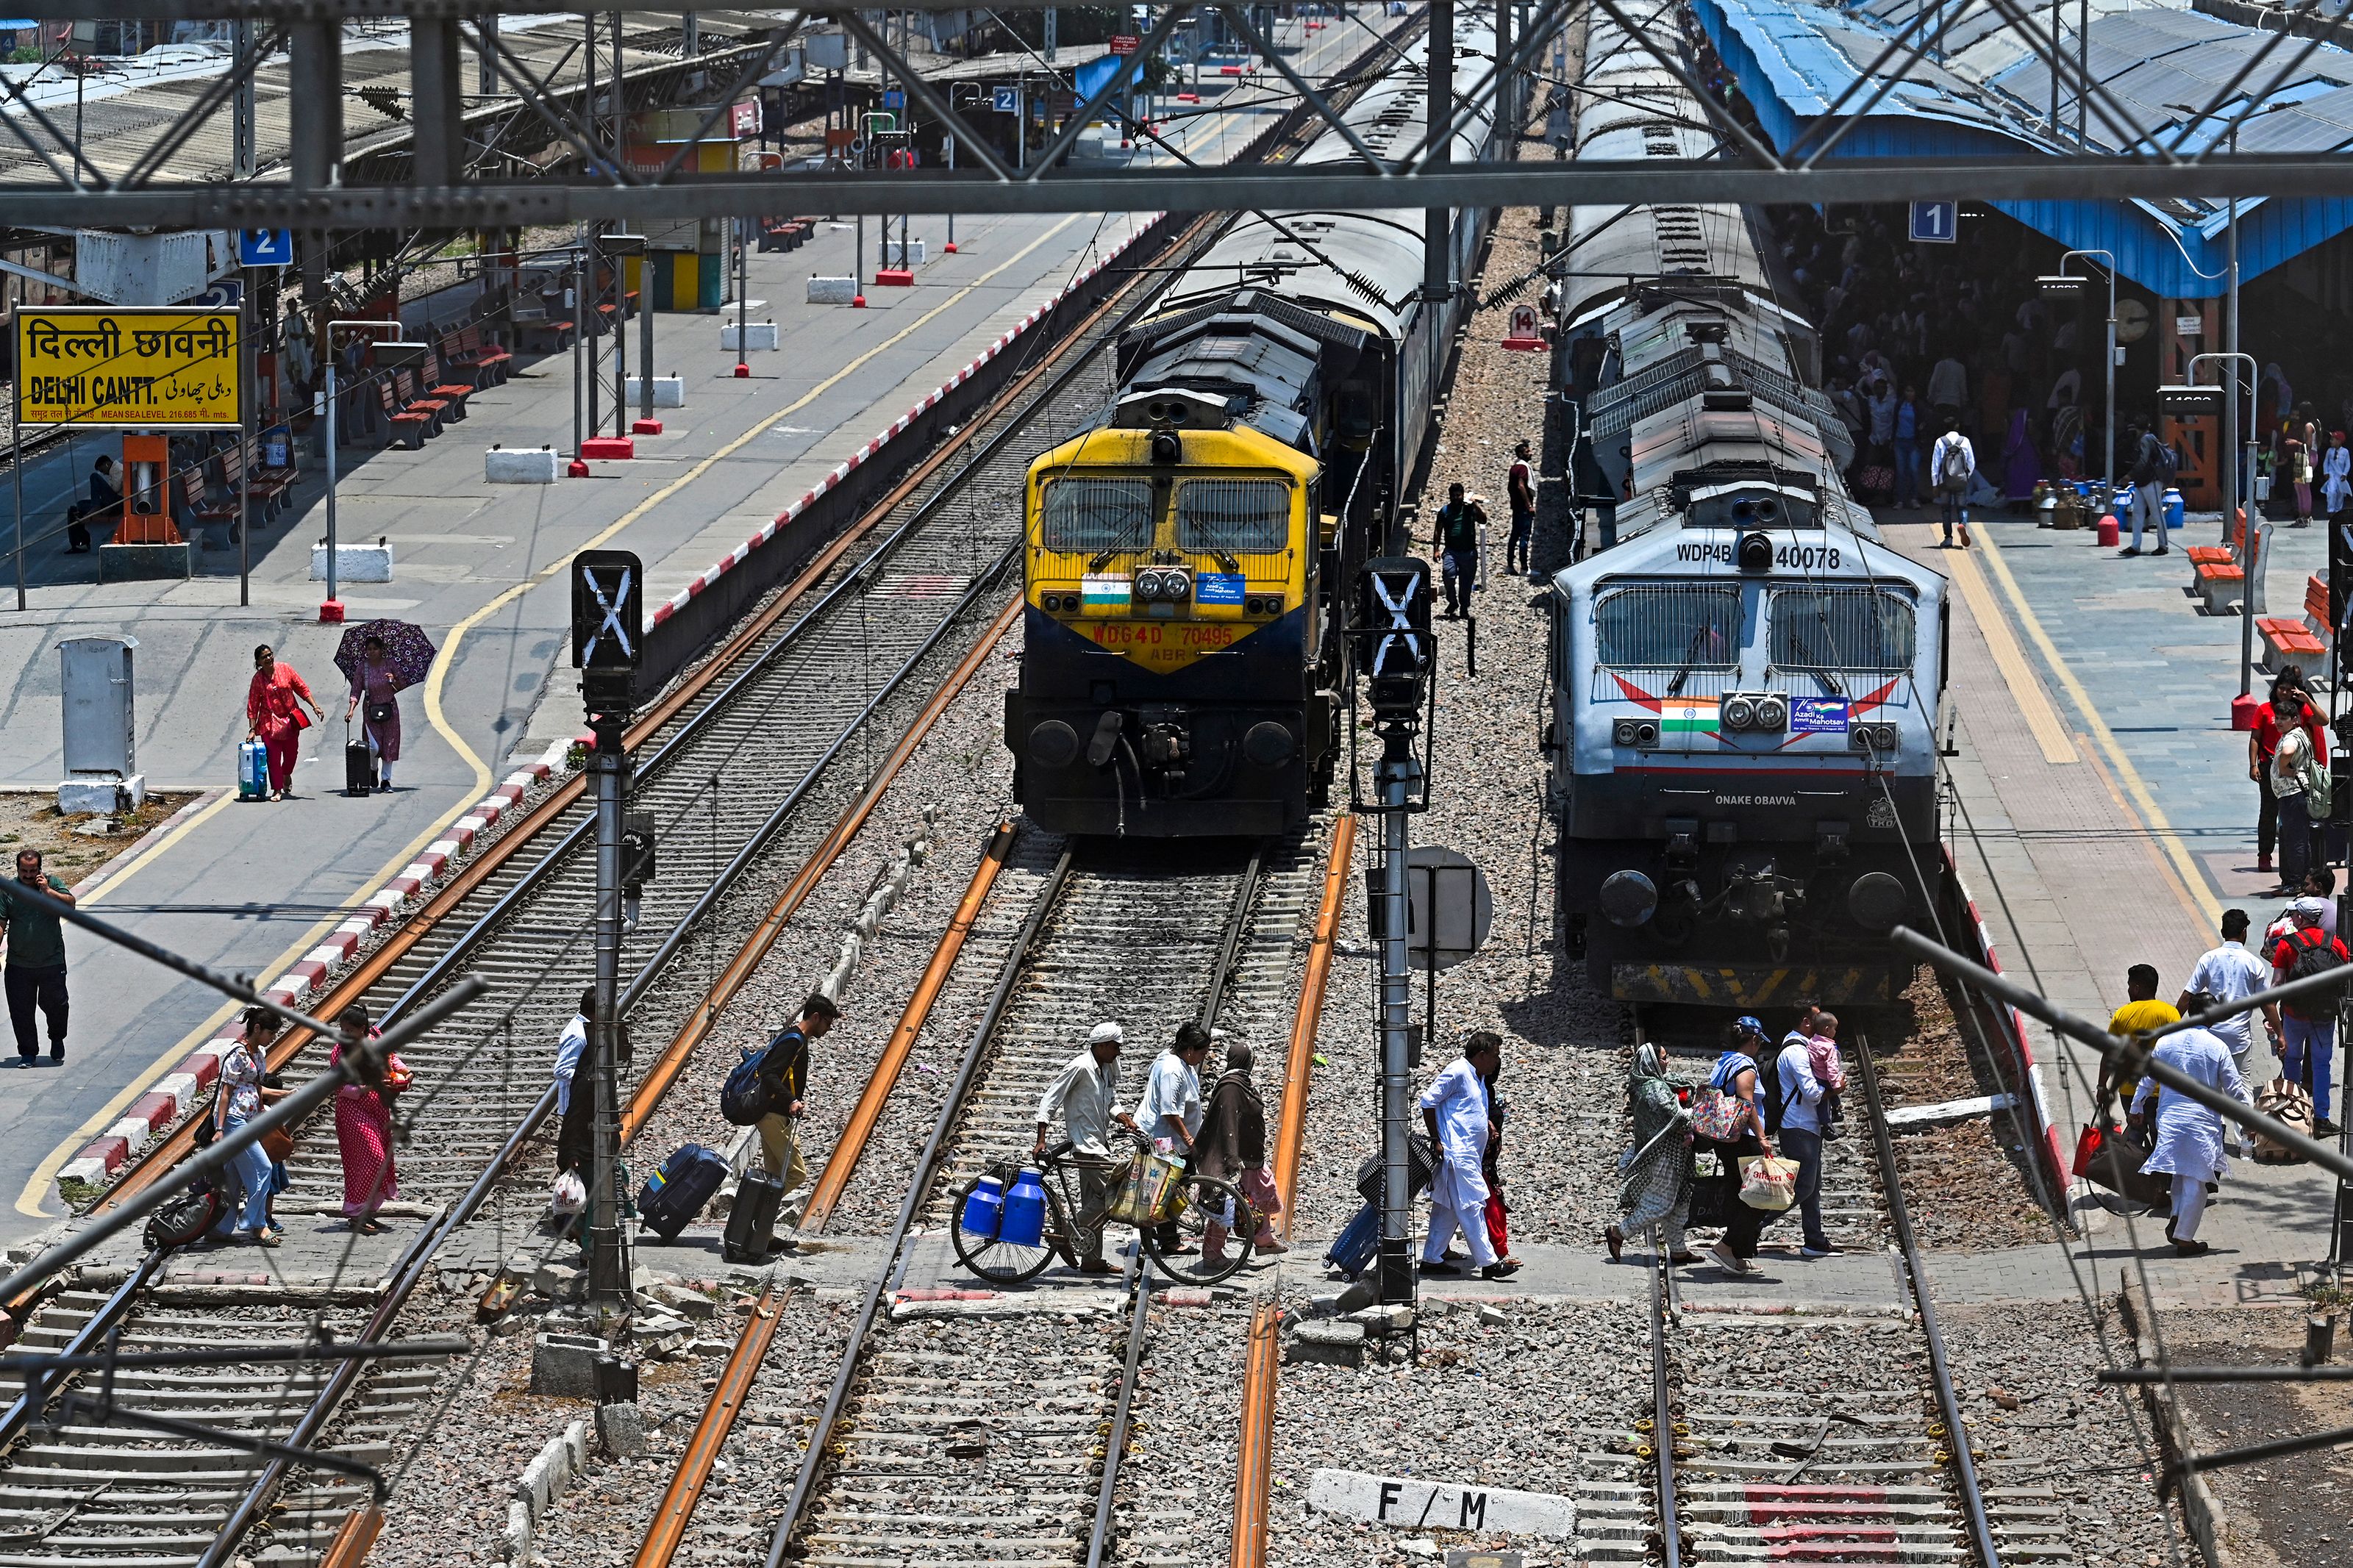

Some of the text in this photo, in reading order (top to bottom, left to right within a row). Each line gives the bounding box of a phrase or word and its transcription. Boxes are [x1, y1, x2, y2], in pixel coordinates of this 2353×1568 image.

[1000, 92, 1012, 108] 2
[1927, 204, 1941, 235] 1
[256, 229, 275, 254] 2
[1515, 312, 1534, 331] 14
[26, 318, 121, 359] दिल्ली
[132, 318, 231, 359] छावनी
[30, 375, 158, 405] DELHI CANTT.
[50, 410, 63, 418] तल
[101, 410, 125, 418] MEAN
[125, 410, 140, 418] SEA
[141, 410, 166, 418] LEVEL
[169, 410, 197, 418] 216.685
[1677, 544, 1840, 570] WDP4B 40078
[1181, 627, 1232, 645] 70495
[1150, 648, 1186, 661] ABR
[1715, 795, 1796, 806] ONAKE OBAVVA
